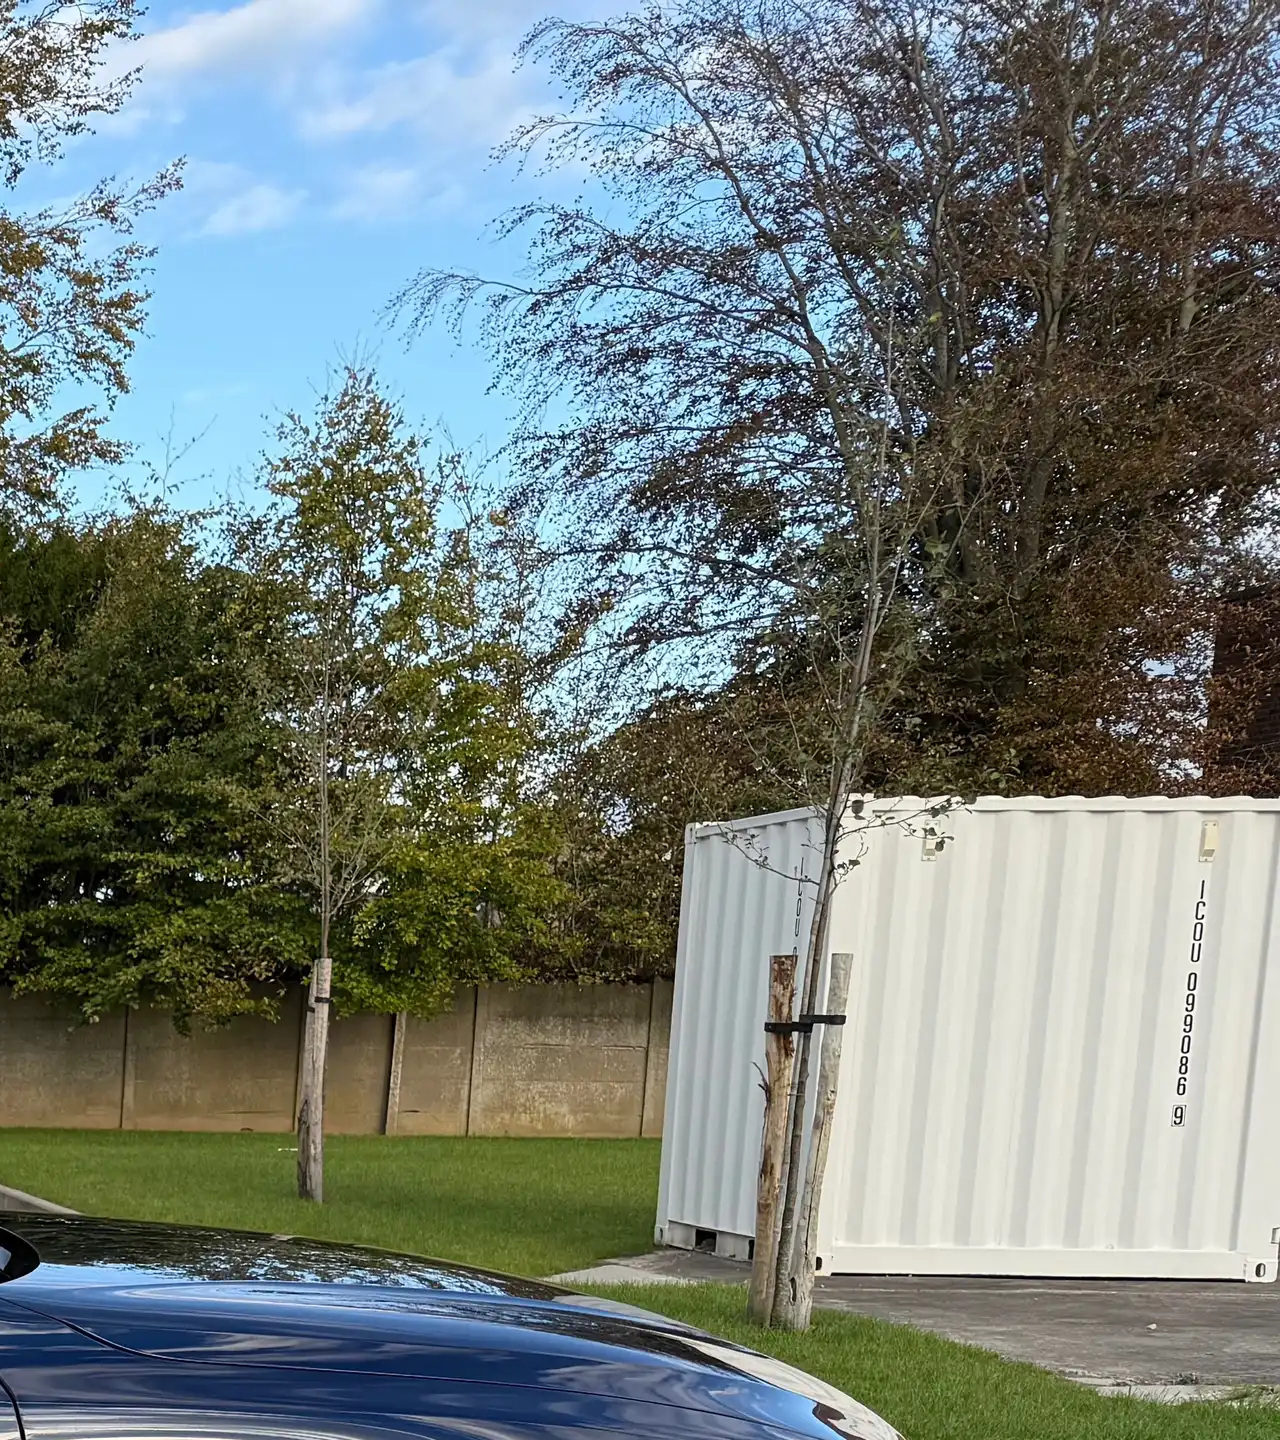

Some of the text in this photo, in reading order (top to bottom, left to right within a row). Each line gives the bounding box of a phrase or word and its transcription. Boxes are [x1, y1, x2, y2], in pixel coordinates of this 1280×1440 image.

[1173, 879, 1206, 1126] ICOU 099086 9
